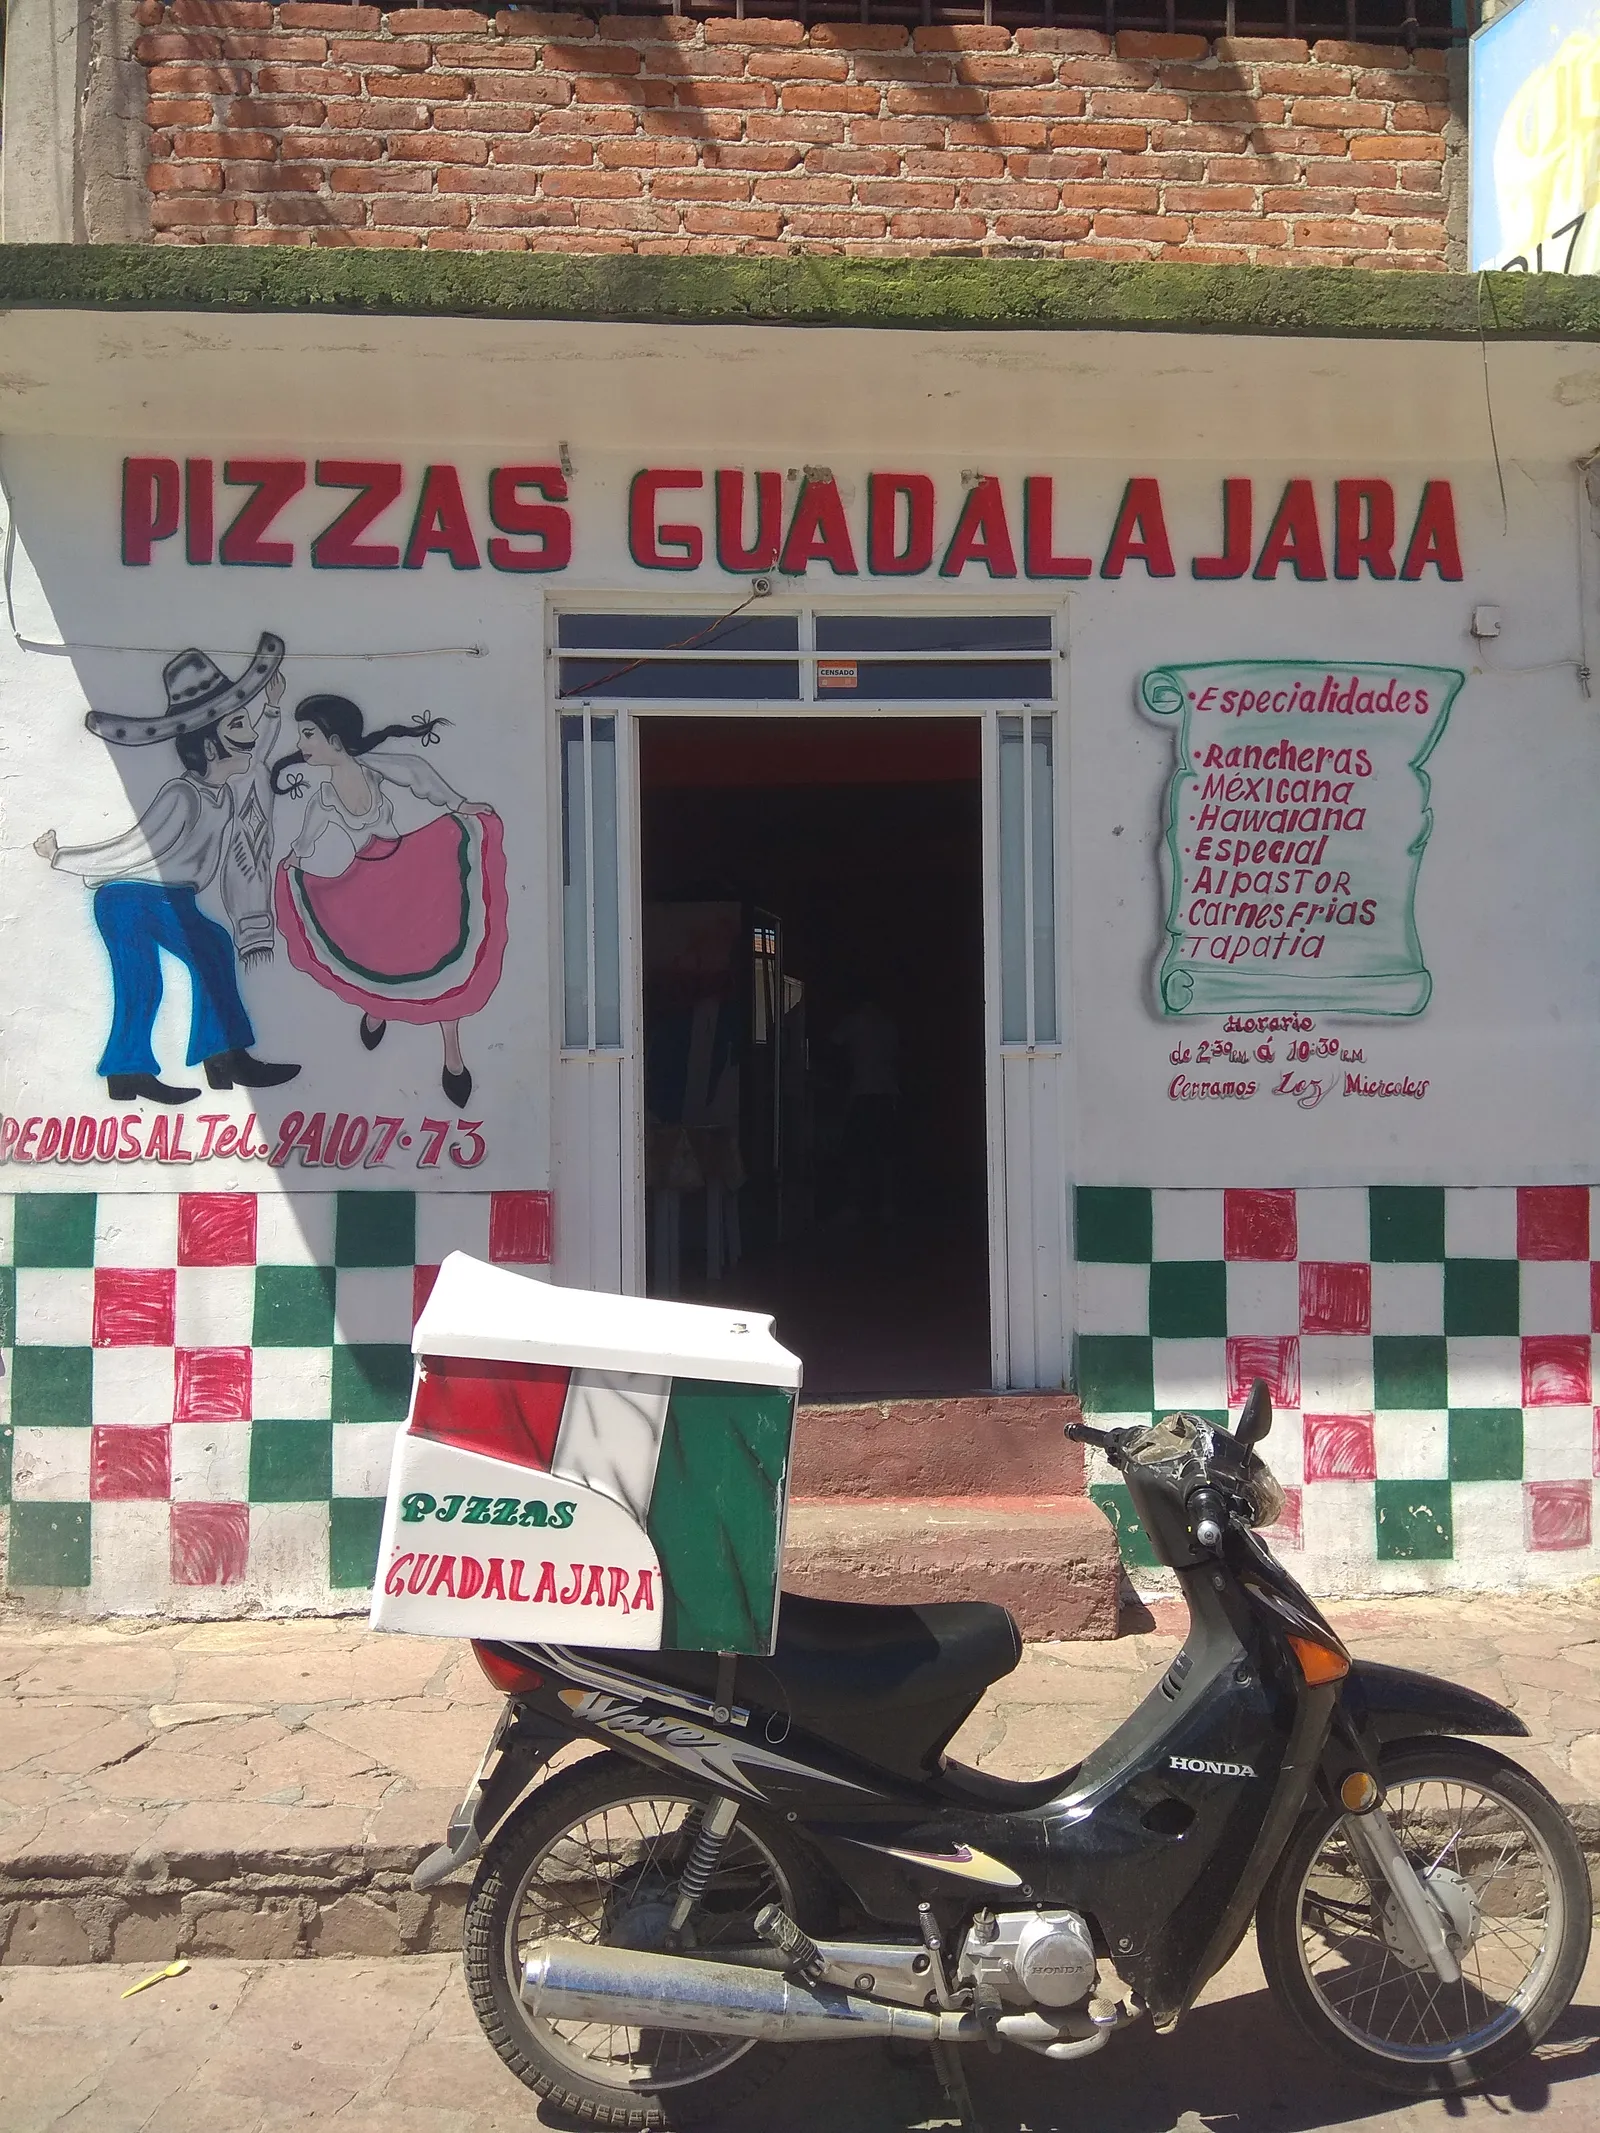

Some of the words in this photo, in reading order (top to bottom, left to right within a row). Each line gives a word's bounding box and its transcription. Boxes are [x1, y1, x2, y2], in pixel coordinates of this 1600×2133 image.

[120, 457, 572, 573] PIZZAS
[628, 468, 1464, 582] GUADALAJARA
[1195, 675, 1430, 717] Especialidades
[1202, 739, 1373, 777] Rancheras
[1196, 803, 1367, 834] Hawaiana
[1194, 835, 1330, 867] Especial
[1185, 927, 1326, 964] Tapatia
[1223, 1011, 1316, 1034] Horario
[1169, 1040, 1192, 1065] de
[1167, 1073, 1260, 1100] Cerramos
[400, 1491, 578, 1530] PIZZAS
[384, 1551, 655, 1616] GUADALAJARA
[570, 1690, 722, 1742] Wave
[1168, 1754, 1259, 1779] HONDA
[1030, 1965, 1087, 1976] HONDA
